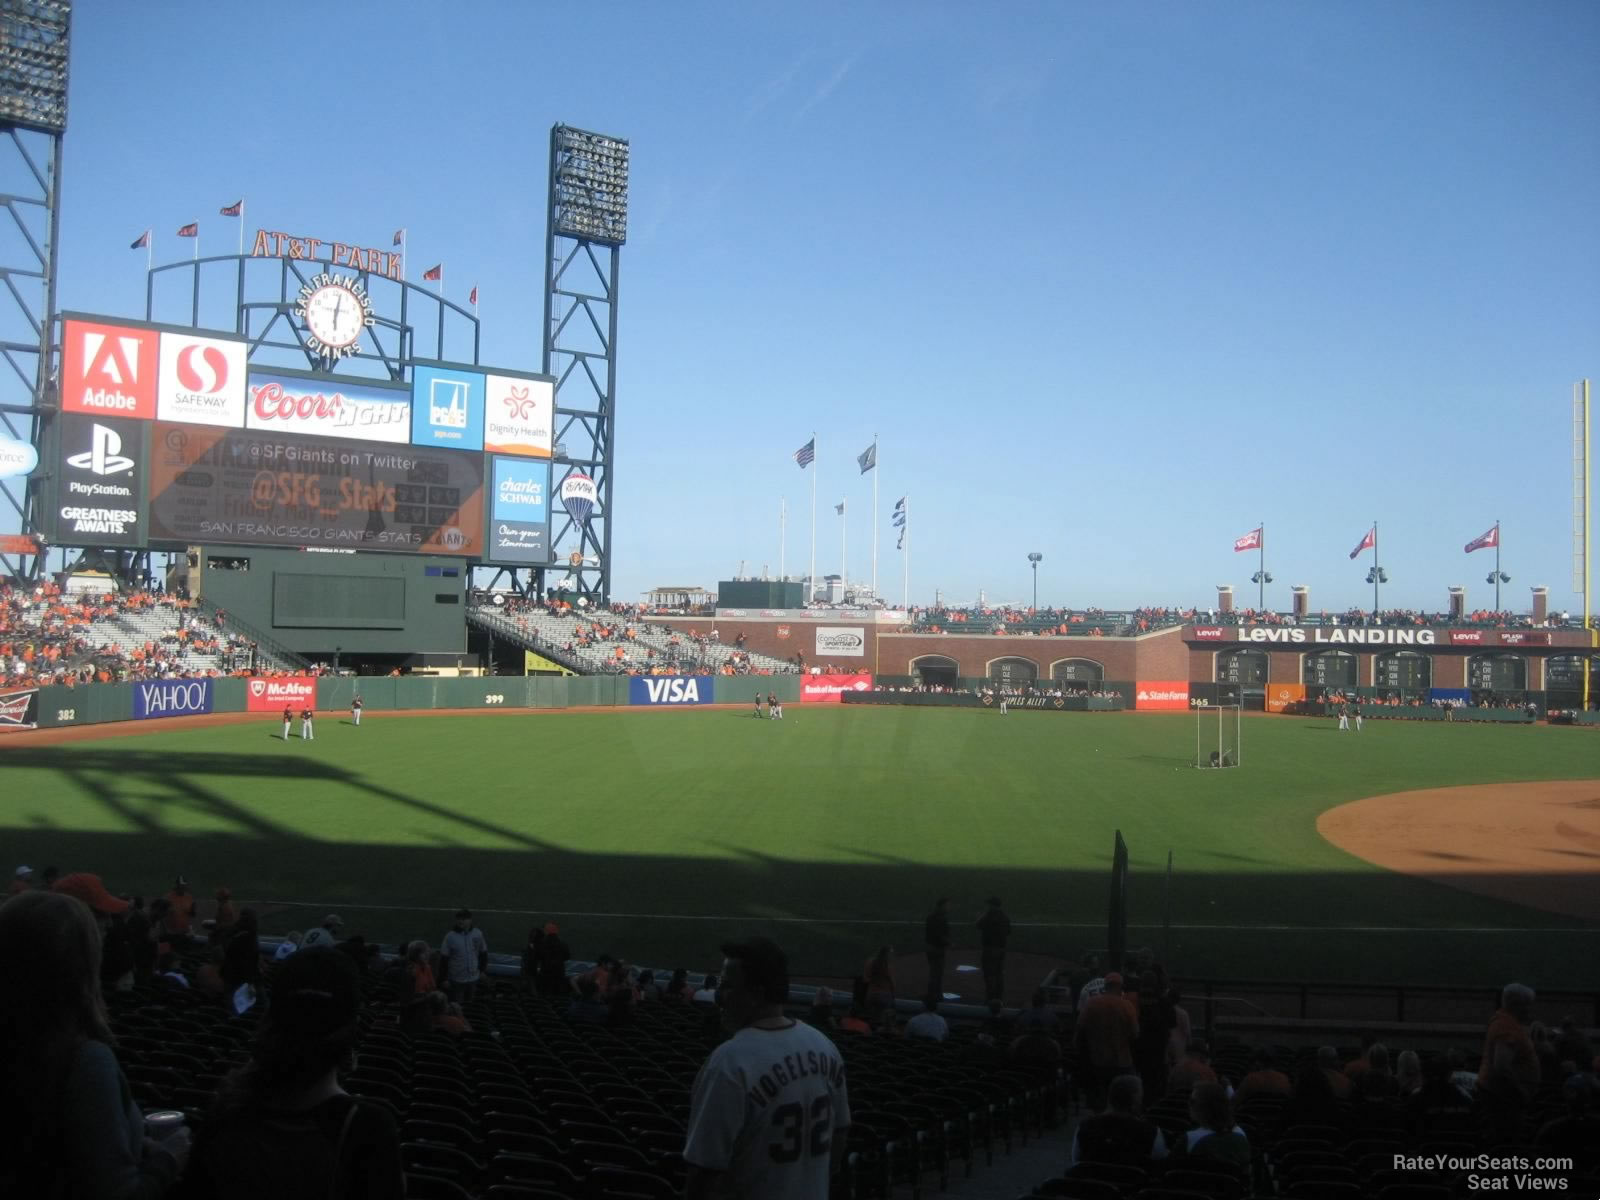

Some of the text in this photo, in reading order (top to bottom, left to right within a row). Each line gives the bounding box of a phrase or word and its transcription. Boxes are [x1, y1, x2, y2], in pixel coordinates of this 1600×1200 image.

[251, 229, 401, 281] AT&T PARK
[295, 273, 375, 326] SAN FRANCISCO
[306, 337, 361, 359] GIANTS
[82, 387, 136, 410] Adobe
[175, 393, 227, 408] SAFEWAY
[251, 382, 408, 427] Coors LIGHT
[489, 423, 548, 438] Dignity Health
[250, 444, 334, 463] @SFGiants
[340, 454, 360, 466] on
[365, 453, 418, 470] Twitter
[70, 482, 130, 496] PlayStation
[252, 470, 397, 517] @SFG_Stats
[500, 477, 542, 494] charles
[500, 492, 542, 505] SCHWAB
[61, 506, 137, 522] GREATNESS
[74, 520, 125, 534] AWAITS
[200, 521, 233, 535] SAN
[237, 523, 320, 538] FRANCISCO
[324, 528, 375, 541] GIANTS
[378, 530, 422, 544] STATS
[498, 524, 540, 541] Own your
[1314, 628, 1435, 644] LANDING
[268, 682, 312, 695] McAfee
[643, 678, 700, 702] VISA
[142, 682, 206, 716] YAHOO!
[486, 694, 504, 704] 399
[1026, 698, 1046, 706] ALLEY
[1190, 698, 1208, 706] 365
[58, 709, 75, 720] 382
[748, 1050, 844, 1108] VOGELSONG
[768, 1094, 831, 1164] 32
